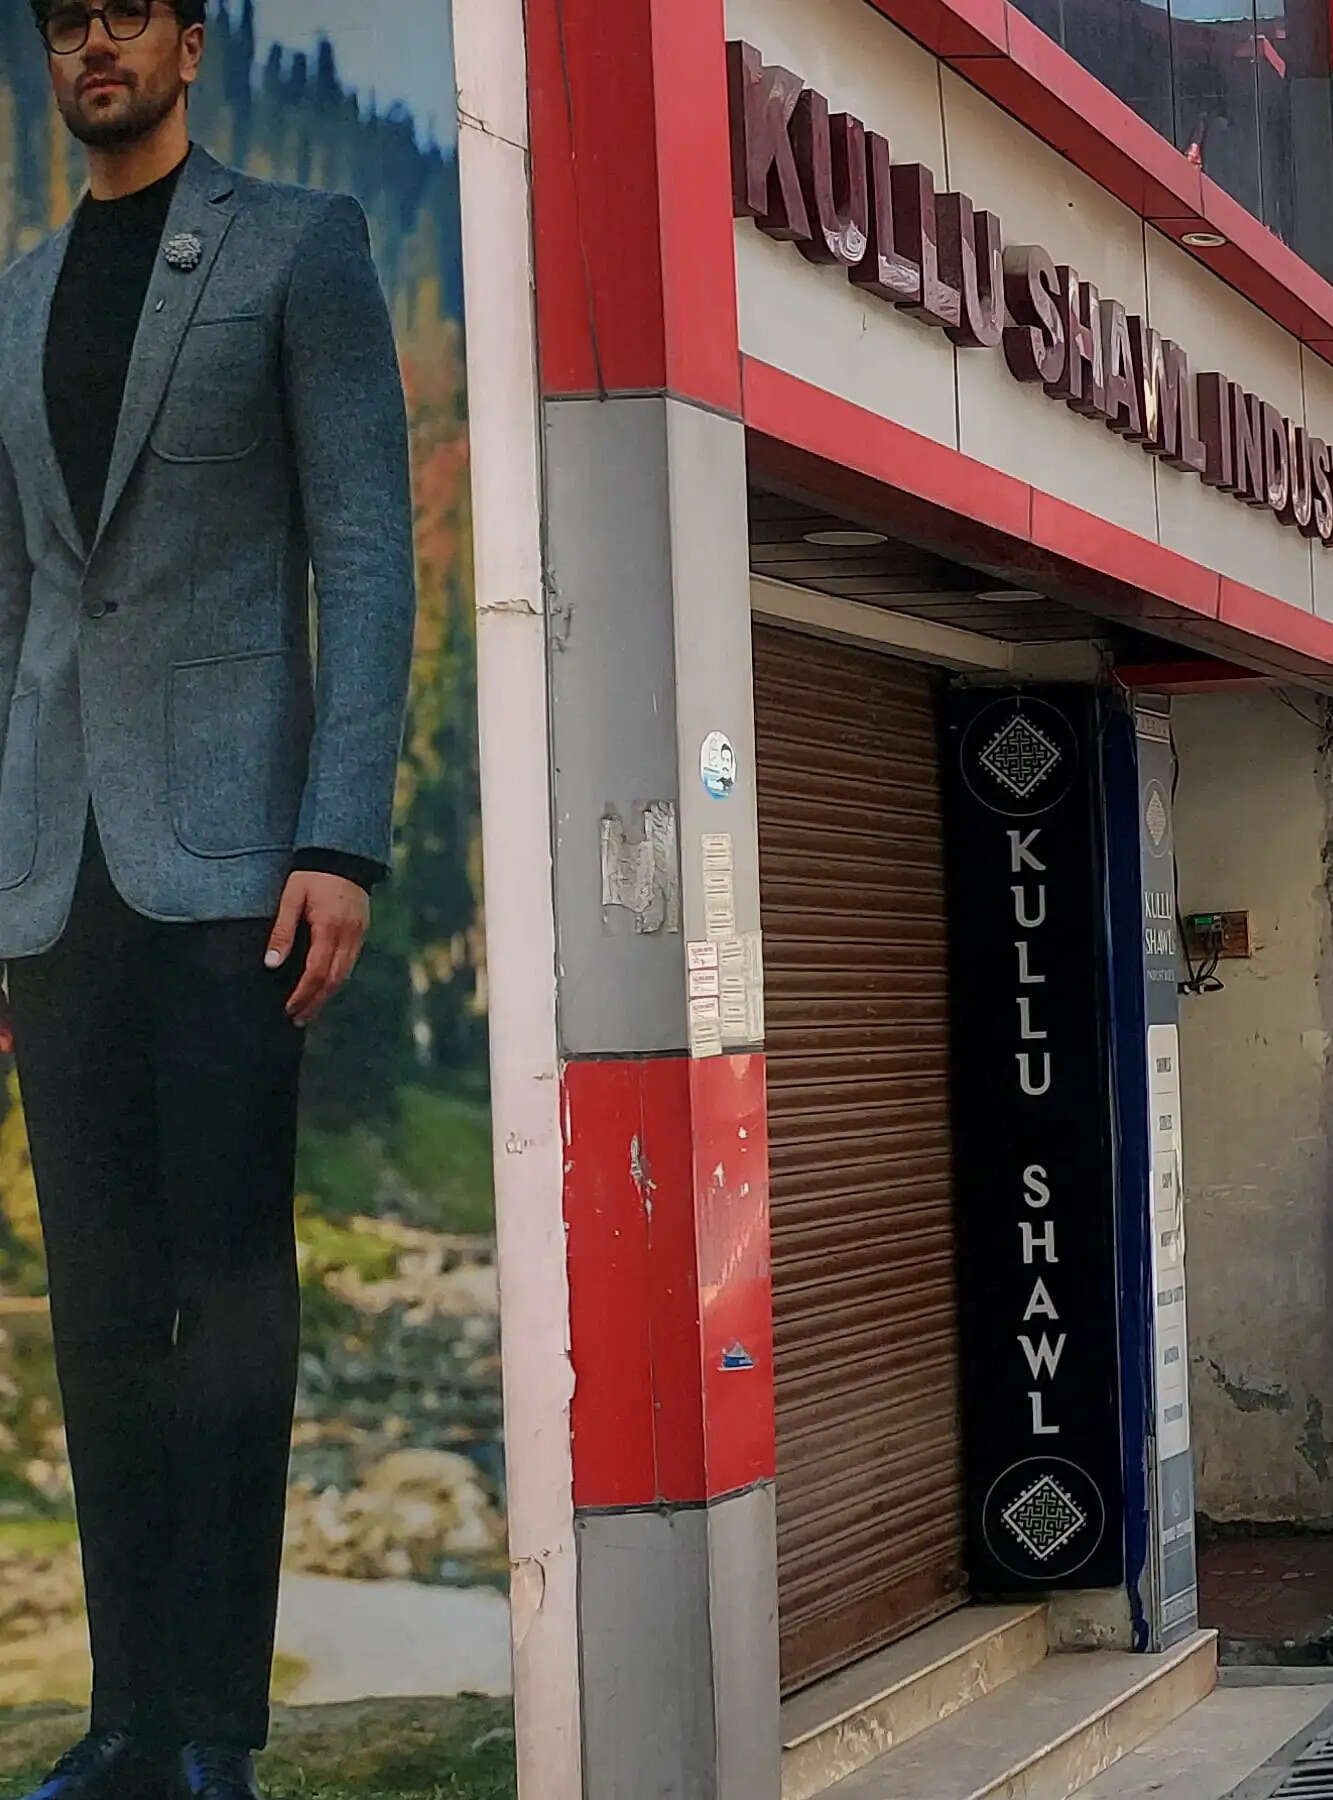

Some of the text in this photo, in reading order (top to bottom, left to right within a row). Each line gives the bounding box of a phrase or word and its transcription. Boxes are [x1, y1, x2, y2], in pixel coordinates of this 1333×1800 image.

[725, 40, 1002, 348] KULLU
[1006, 829, 1067, 1435] KULLU SHAWL
